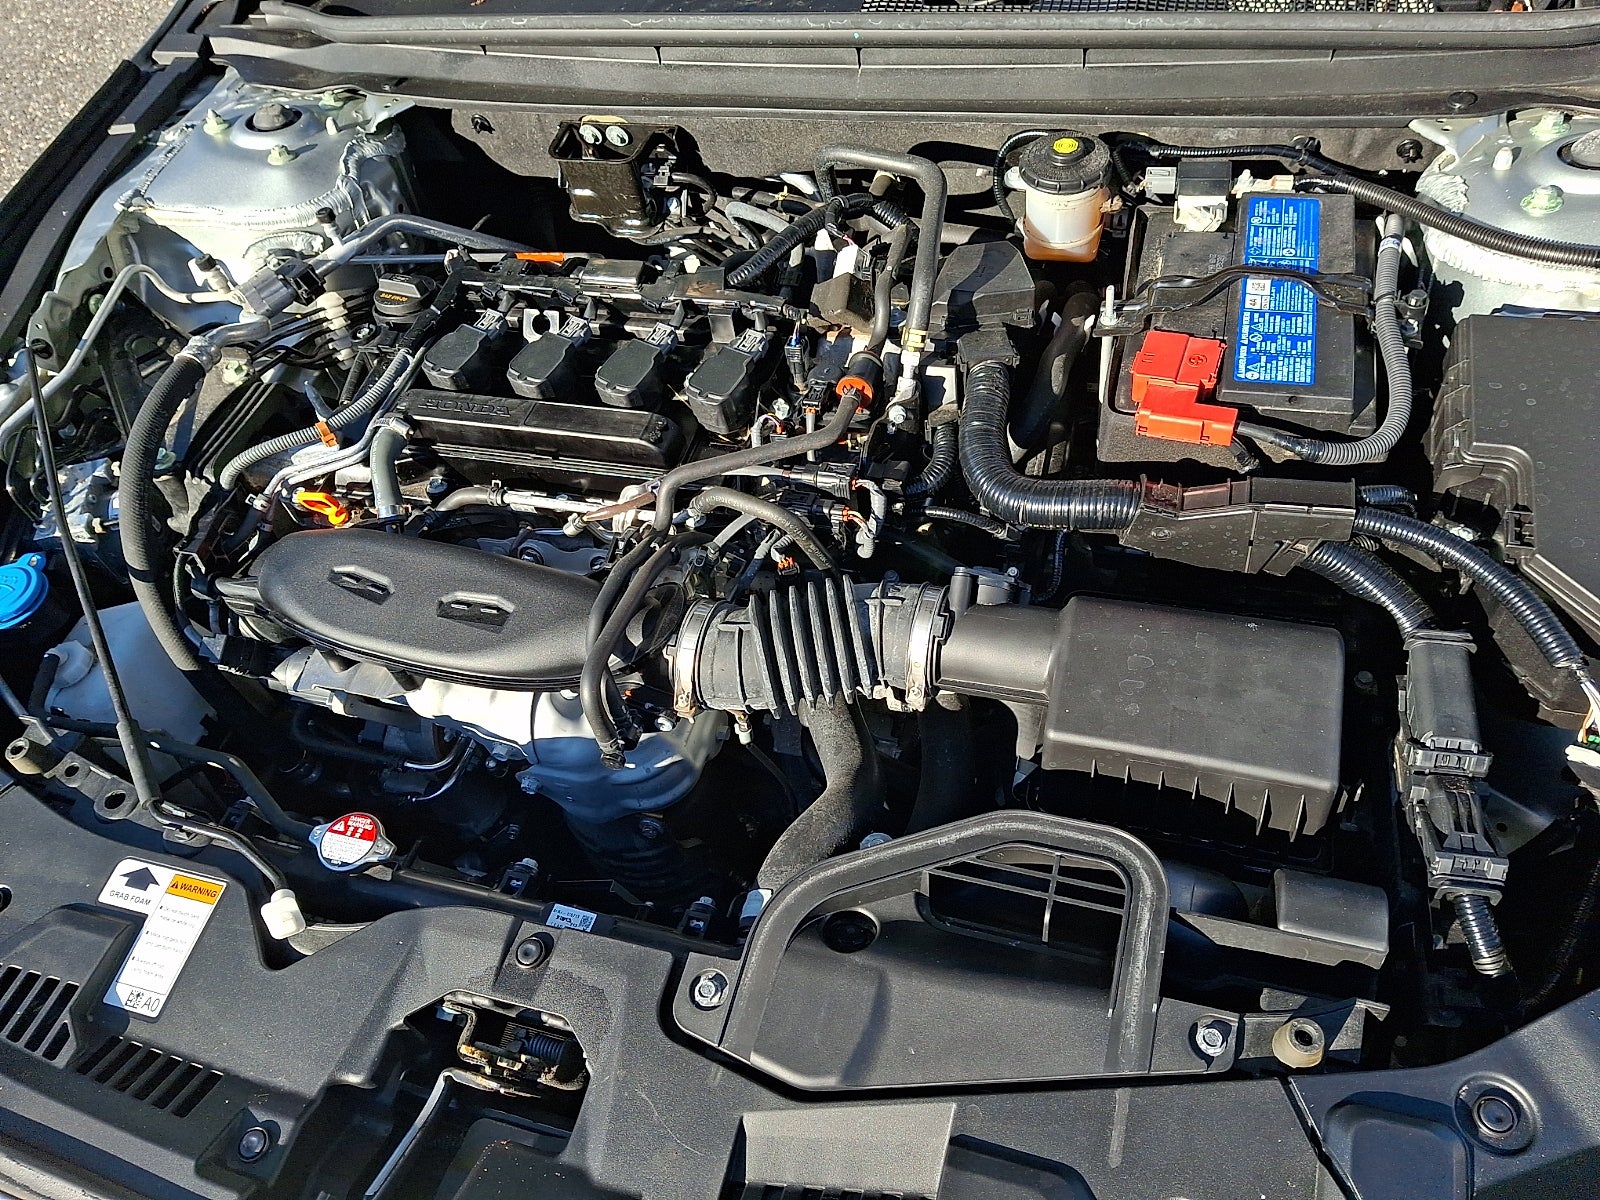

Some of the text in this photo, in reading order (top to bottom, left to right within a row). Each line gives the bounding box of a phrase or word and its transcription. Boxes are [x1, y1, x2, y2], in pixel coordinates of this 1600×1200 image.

[417, 398, 512, 418] HONDA
[109, 889, 152, 906] GRAB FOAM
[180, 882, 218, 898] WARNING
